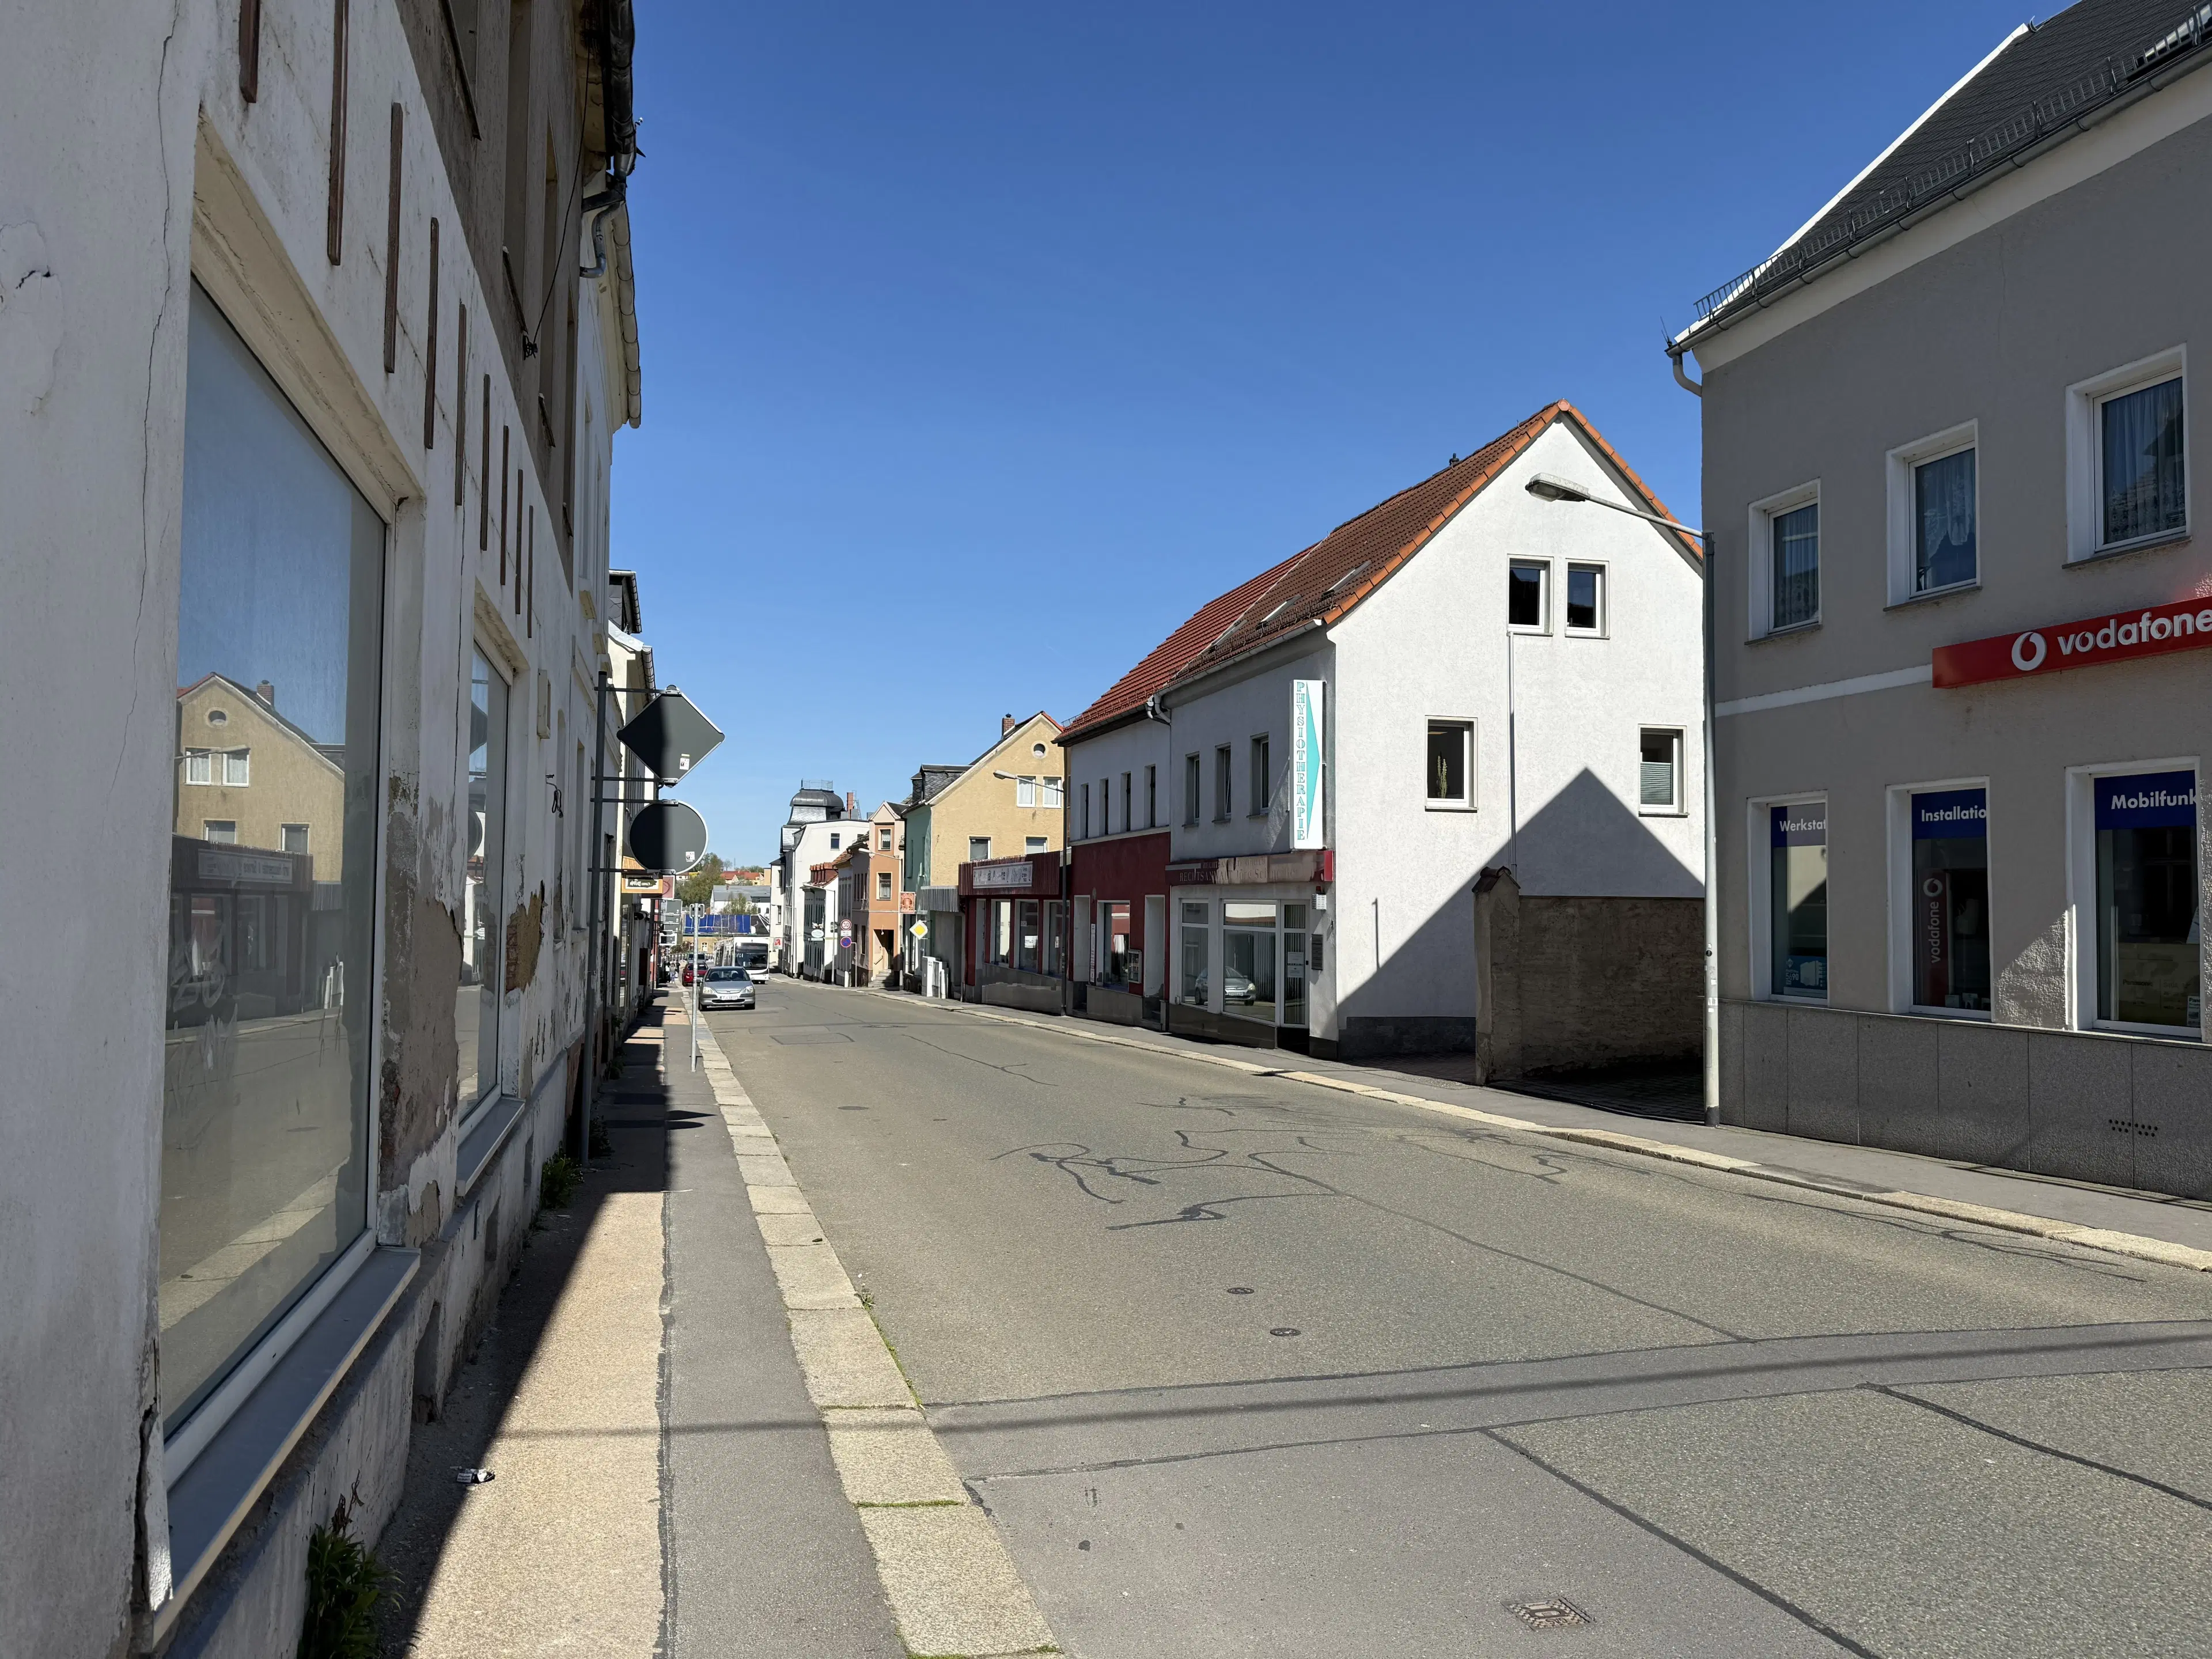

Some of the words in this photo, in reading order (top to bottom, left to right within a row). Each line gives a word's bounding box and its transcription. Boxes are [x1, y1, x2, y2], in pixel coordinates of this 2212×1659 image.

[2057, 609, 2212, 656] vodafone
[1296, 681, 1306, 840] PHYSIOTHERAPIE
[1921, 805, 1987, 822] Installatio
[2111, 789, 2197, 809] Mobilfunk
[1927, 901, 1941, 964] vodafone
